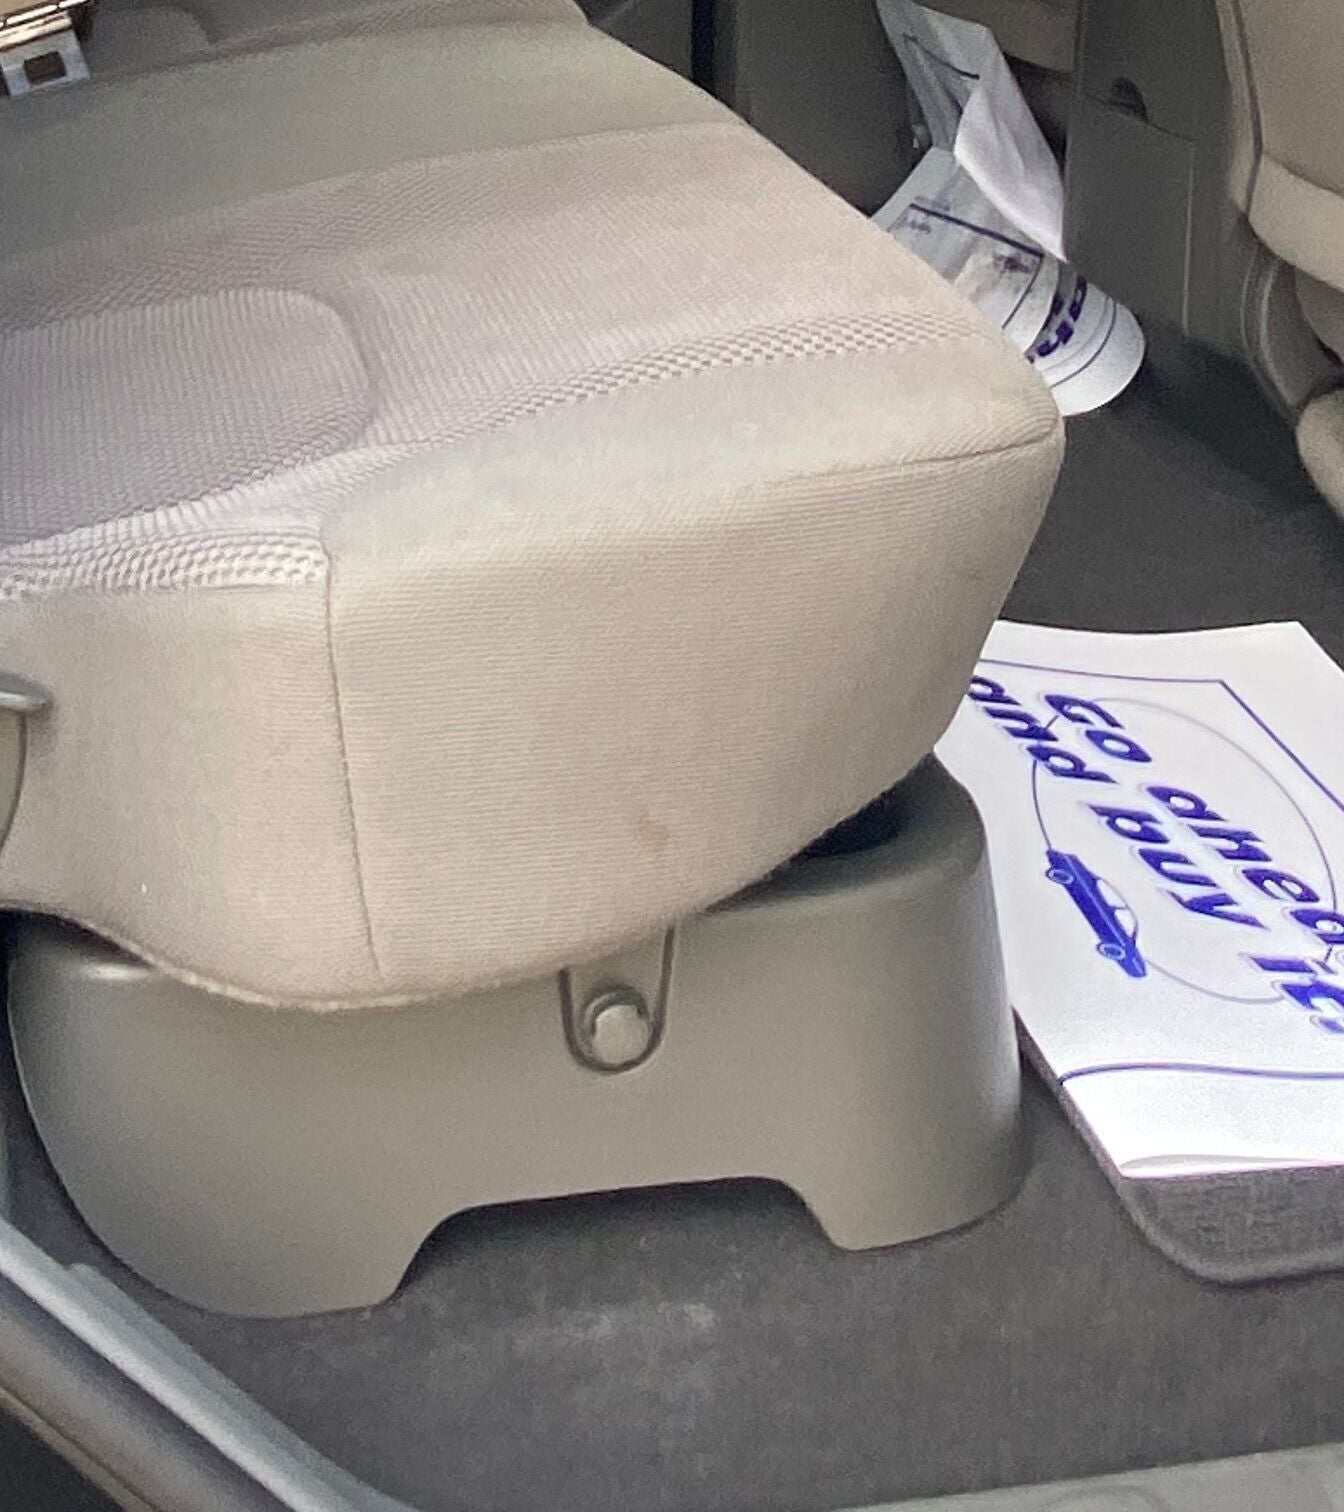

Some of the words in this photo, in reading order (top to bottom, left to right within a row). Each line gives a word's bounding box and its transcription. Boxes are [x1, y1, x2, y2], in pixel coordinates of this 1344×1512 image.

[967, 674, 1119, 784] and
[1086, 802, 1269, 930] buy
[1043, 693, 1152, 763] Go
